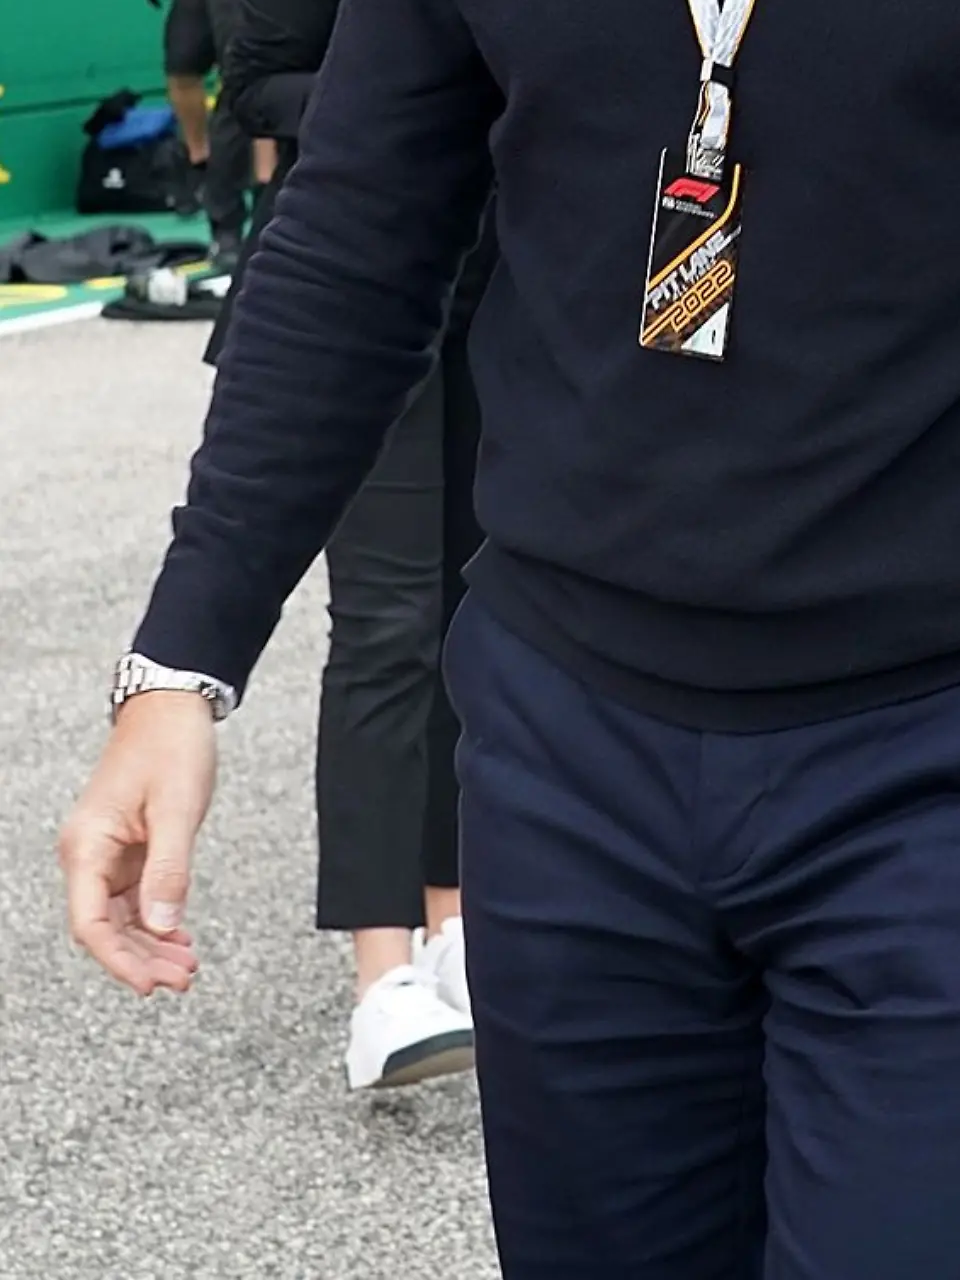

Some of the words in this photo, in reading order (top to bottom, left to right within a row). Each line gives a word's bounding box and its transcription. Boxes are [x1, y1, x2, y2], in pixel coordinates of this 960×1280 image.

[664, 178, 720, 204] F1
[650, 271, 680, 310] PIT
[679, 230, 732, 283] LANE
[670, 260, 732, 333] 2022
